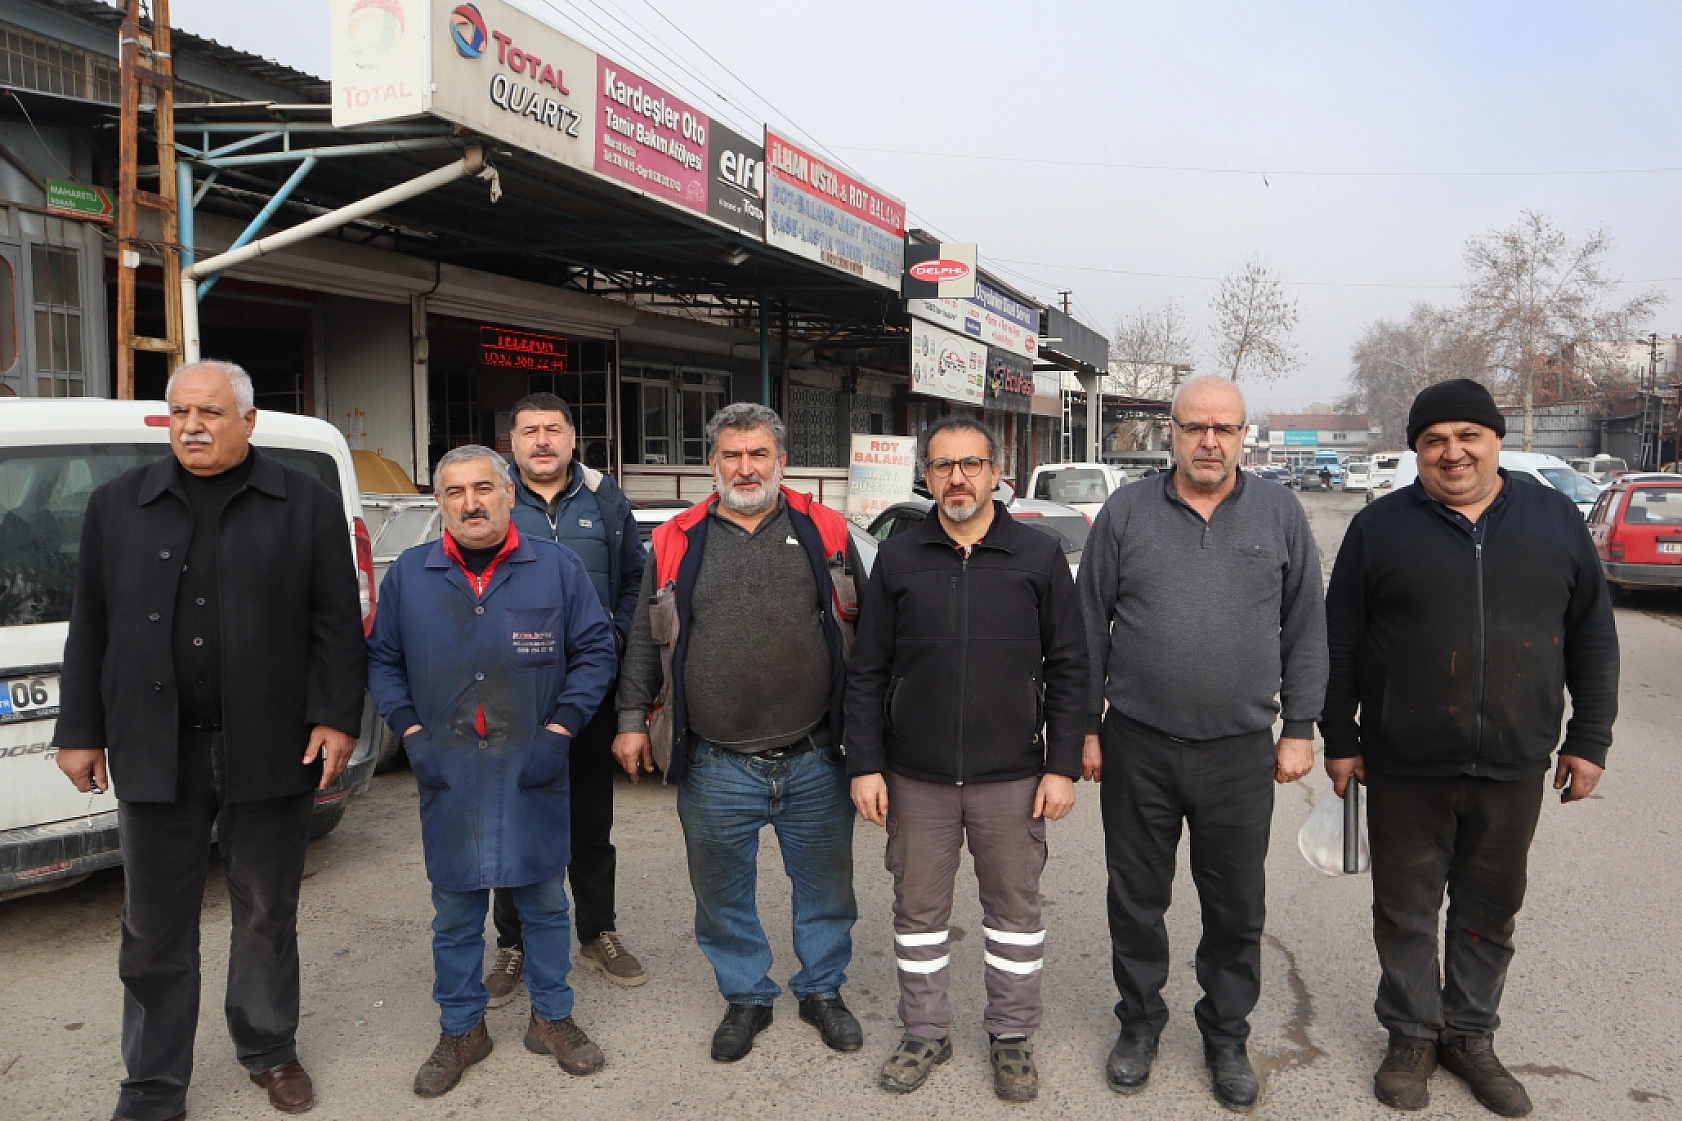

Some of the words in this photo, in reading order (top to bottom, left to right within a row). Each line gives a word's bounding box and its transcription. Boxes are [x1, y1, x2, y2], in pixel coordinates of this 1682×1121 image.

[492, 29, 570, 96] TOTAL
[341, 82, 413, 109] TOTAL
[490, 73, 582, 138] QUARTZ
[604, 67, 680, 131] Kardeşler
[682, 112, 705, 146] Oto
[605, 106, 635, 139] Tamir
[636, 122, 668, 153] Bakım
[719, 149, 755, 189] elf
[810, 162, 838, 199] USTA
[849, 184, 869, 211] ROT
[869, 195, 901, 230] BALANS
[916, 267, 965, 275] DELPHI
[854, 451, 912, 466] BALANS
[870, 441, 899, 453] ROT
[866, 470, 898, 481] JANT
[11, 680, 48, 708] 06
